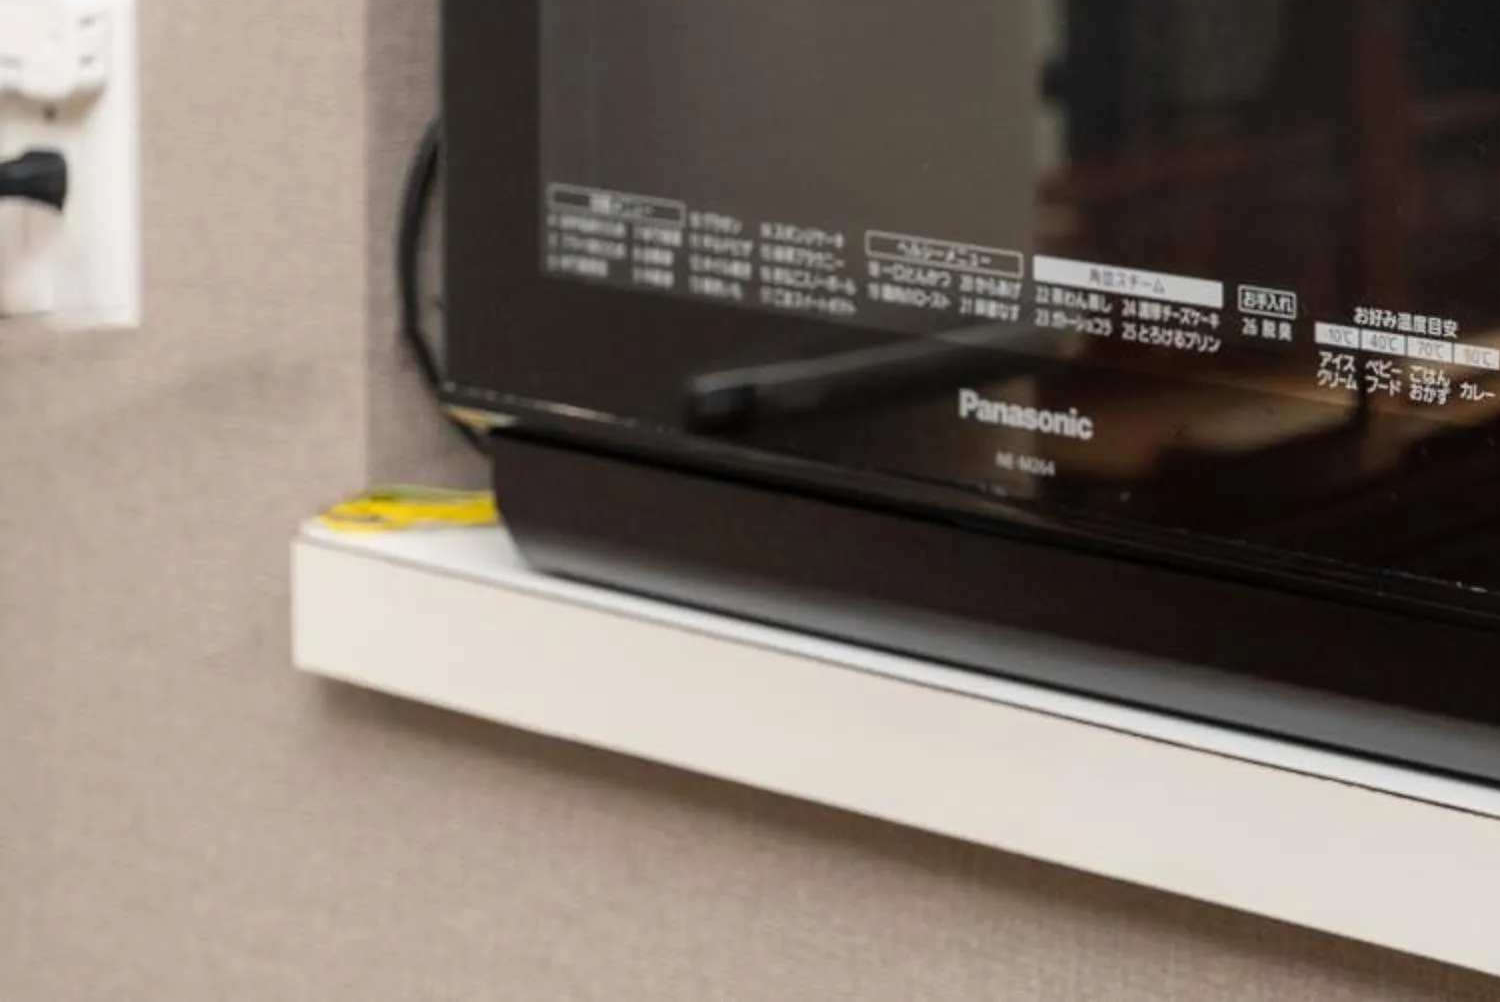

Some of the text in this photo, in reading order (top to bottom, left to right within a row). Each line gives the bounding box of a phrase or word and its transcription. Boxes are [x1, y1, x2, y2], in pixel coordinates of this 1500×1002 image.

[1243, 290, 1293, 313] お手入れ
[1354, 306, 1459, 339] お好み温度目安
[1138, 324, 1222, 353] とろけるプリン
[1317, 351, 1357, 373] アイス
[1316, 369, 1358, 391] クリーム
[1409, 364, 1451, 386] ごはん
[1365, 377, 1402, 397] フード
[1408, 384, 1451, 405] おかず
[1460, 382, 1497, 402] カレー
[958, 388, 1094, 440] Panasonic
